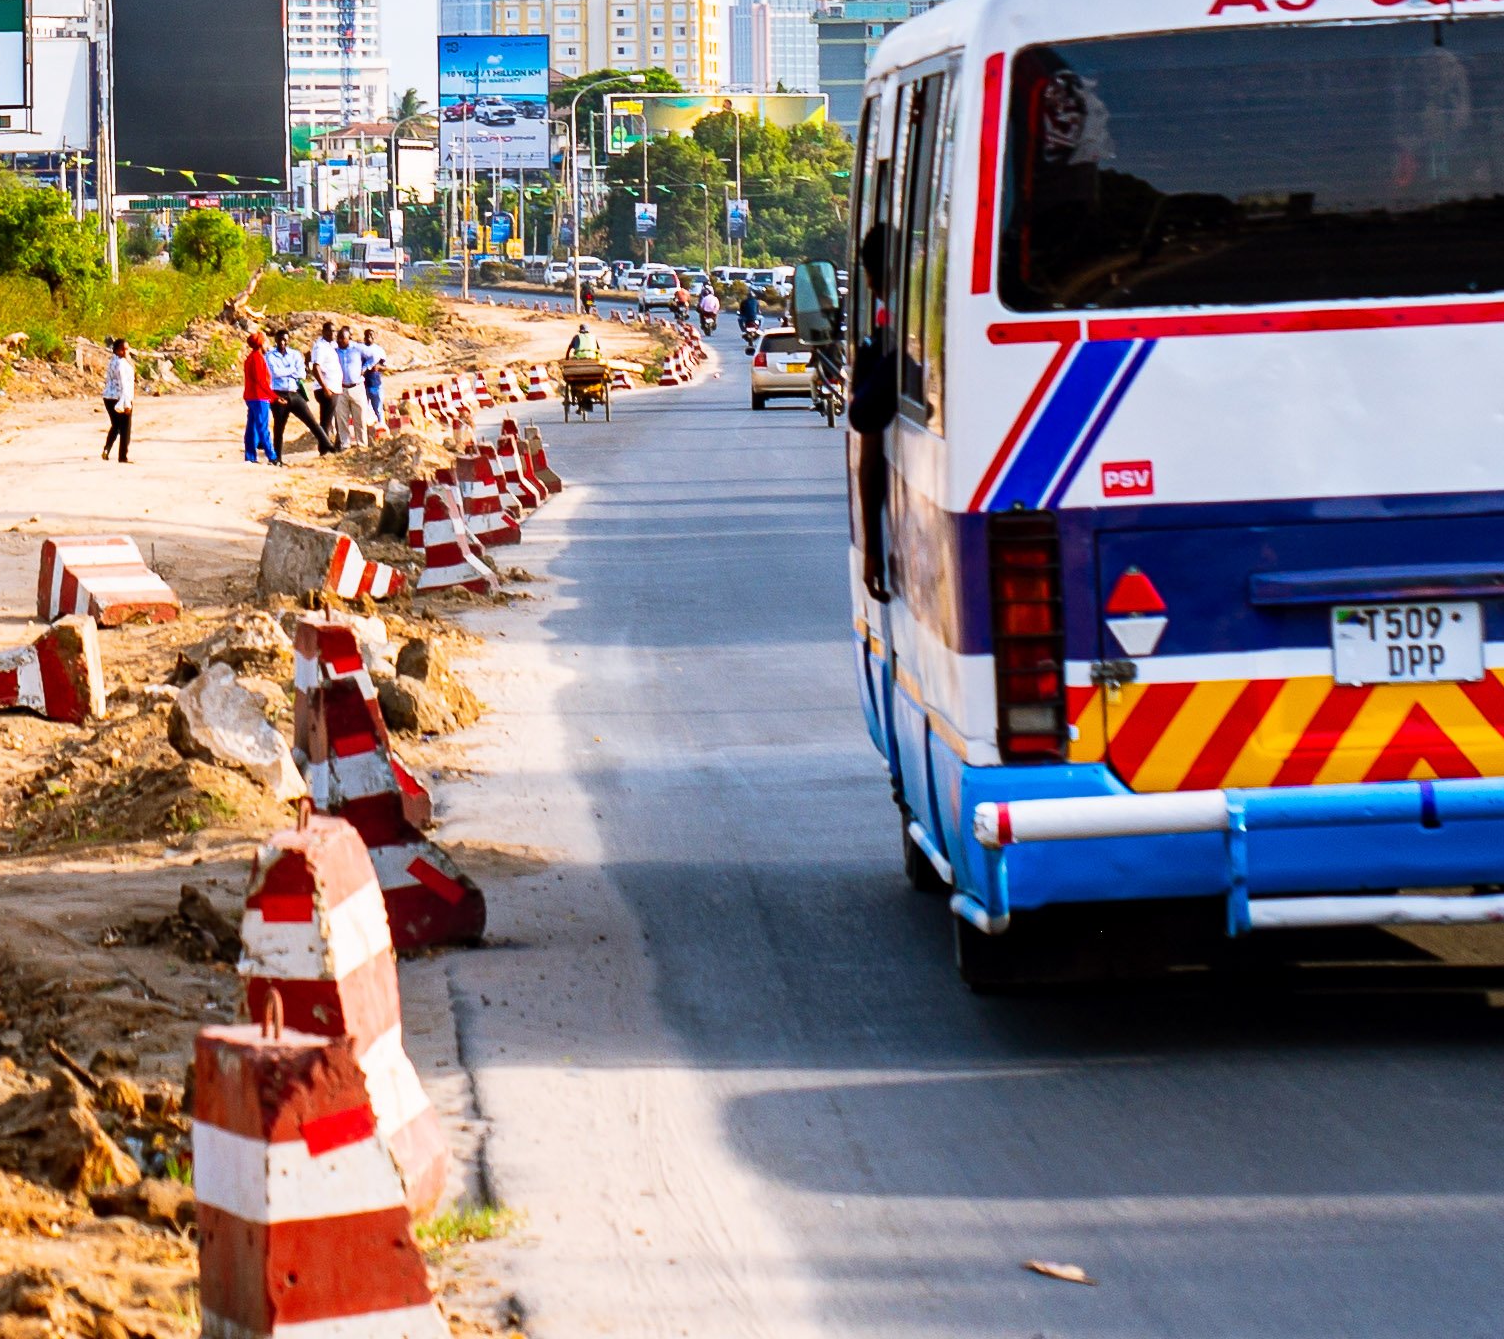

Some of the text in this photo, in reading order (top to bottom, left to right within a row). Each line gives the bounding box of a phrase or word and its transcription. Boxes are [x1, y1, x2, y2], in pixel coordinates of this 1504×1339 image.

[492, 69, 527, 77] MILLION
[1104, 468, 1150, 489] PSV
[1363, 607, 1443, 642] T509
[1387, 644, 1445, 677] DPP
